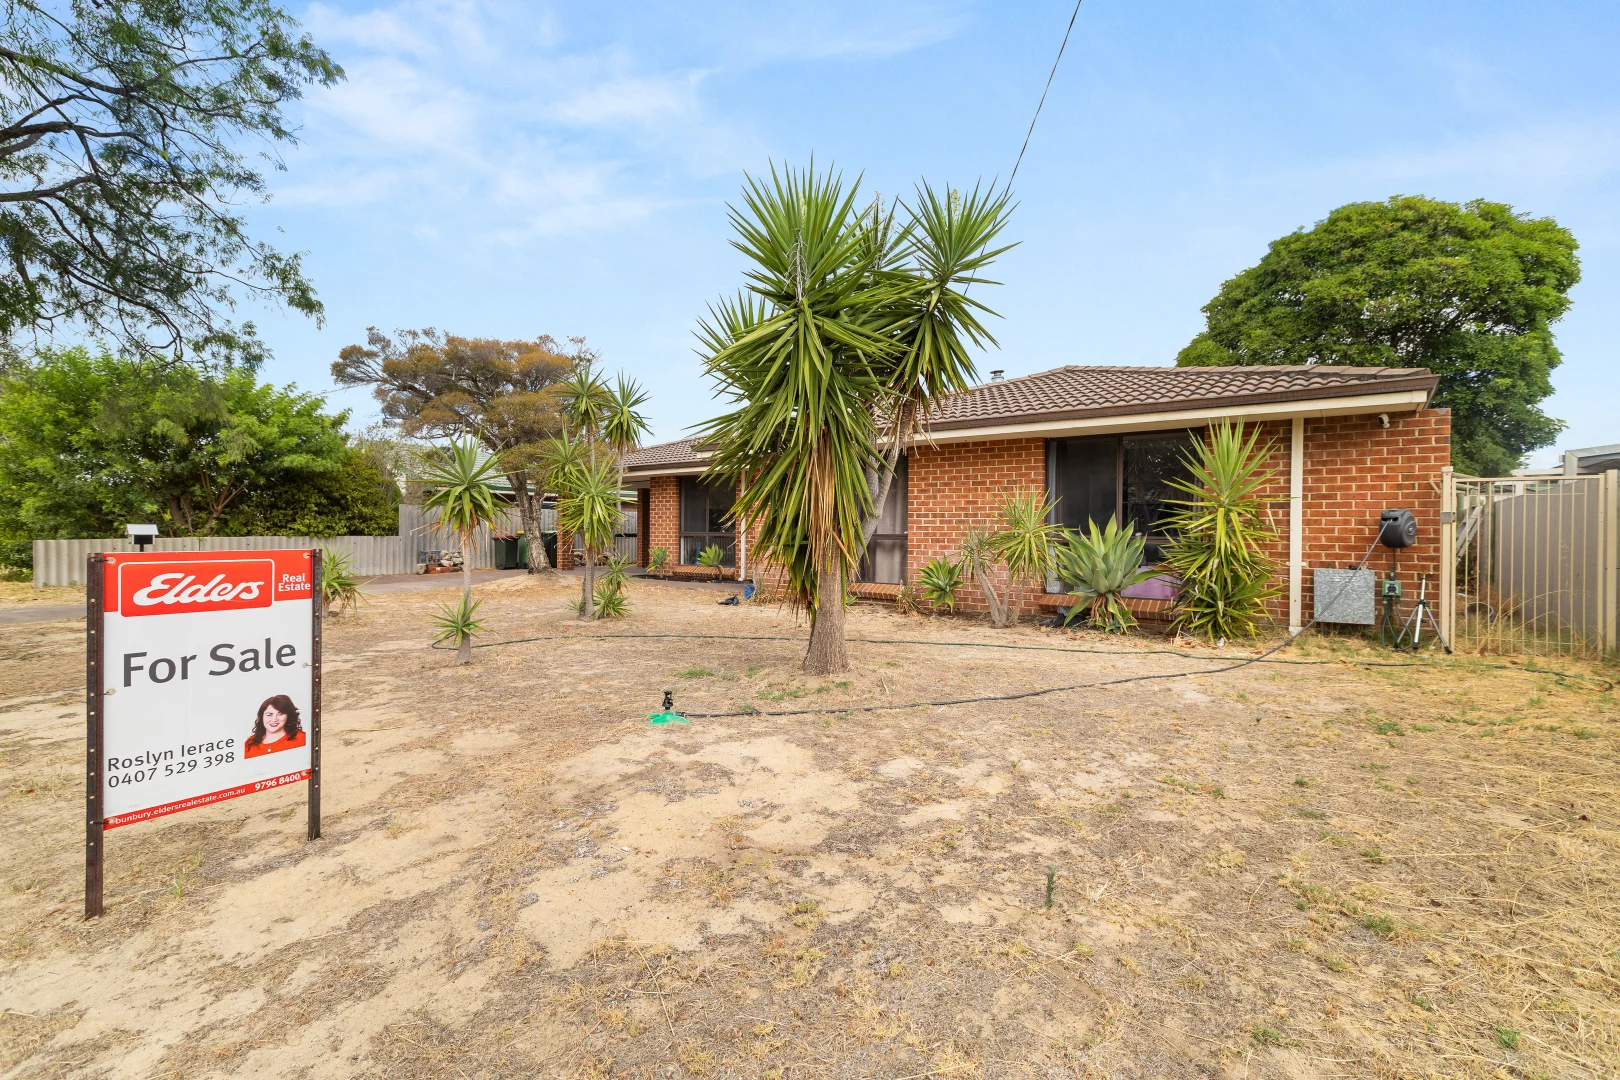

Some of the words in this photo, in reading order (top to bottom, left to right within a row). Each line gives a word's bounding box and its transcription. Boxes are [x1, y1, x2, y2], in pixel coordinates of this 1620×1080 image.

[133, 573, 264, 606] Elders
[278, 582, 311, 592] Estate
[282, 573, 306, 583] Real
[123, 651, 197, 687] For
[208, 637, 296, 676] Sale
[108, 749, 173, 771] Roslyn
[108, 767, 157, 788] 0407
[164, 759, 198, 777] 529
[203, 751, 235, 768] 398
[115, 787, 246, 824] bunbury.eldersrealestate.com.au
[254, 778, 277, 791] 9796
[278, 773, 301, 785] 8400
